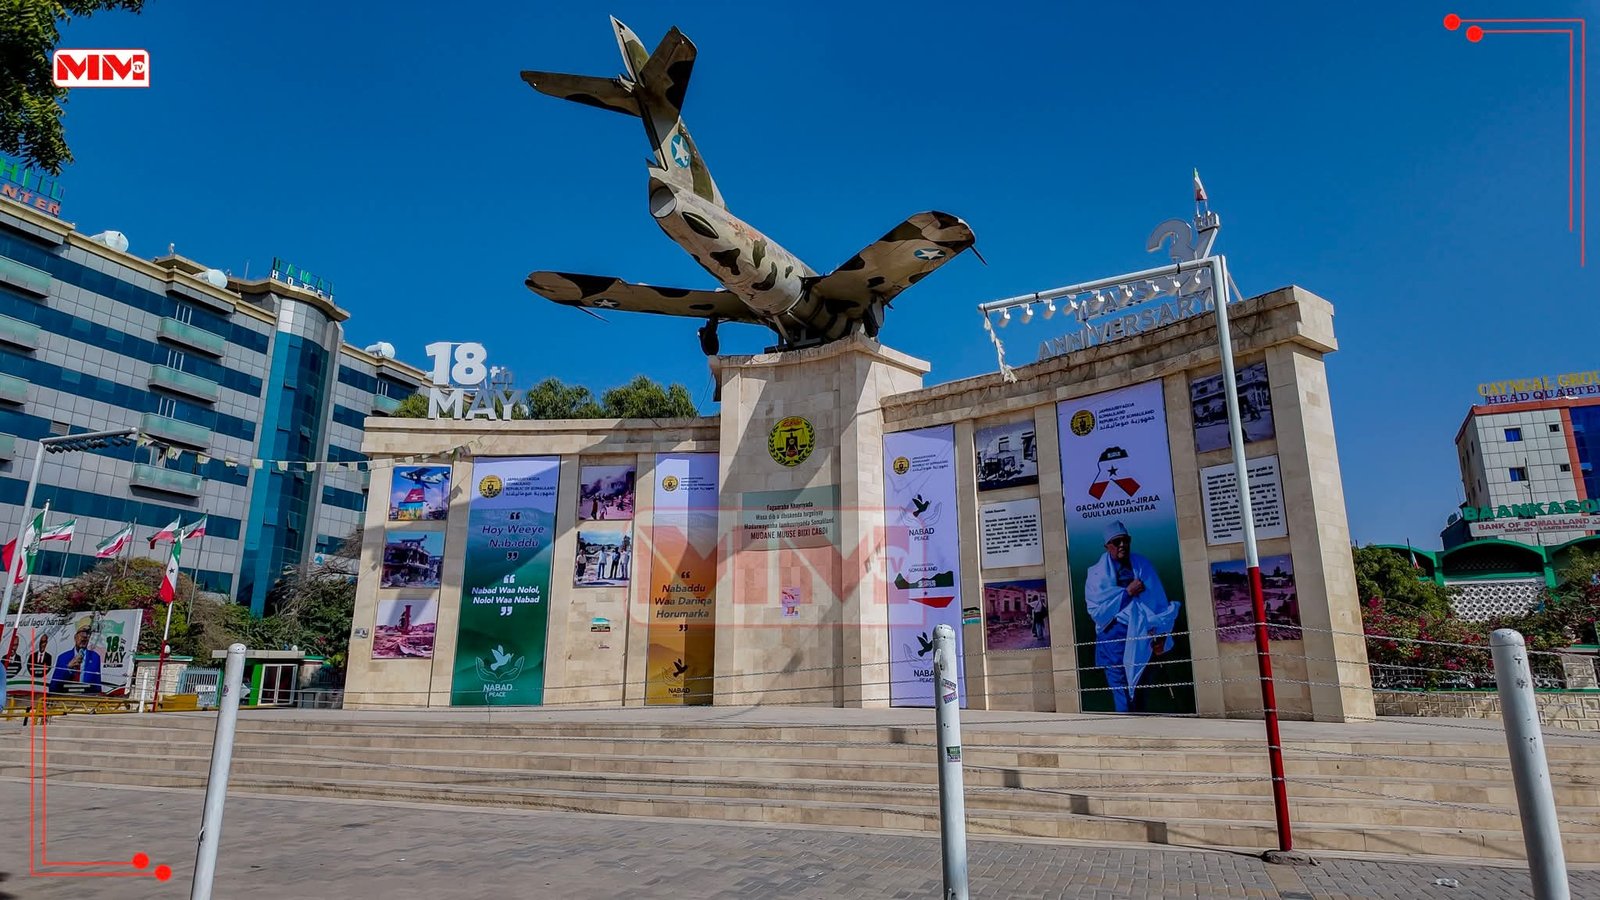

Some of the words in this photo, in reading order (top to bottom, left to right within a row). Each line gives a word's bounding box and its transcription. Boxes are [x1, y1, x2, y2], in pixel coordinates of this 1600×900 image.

[1038, 284, 1214, 361] ANNIVERSARY
[1487, 391, 1530, 405] HEAD
[1533, 384, 1600, 400] QUARTE
[427, 387, 521, 421] MAY
[1076, 502, 1105, 512] GACMO
[1106, 494, 1161, 508] WADA-JIRAA
[1082, 511, 1102, 519] GUUL
[1102, 508, 1122, 517] LAGU
[1123, 503, 1156, 514] HANTAA
[1478, 522, 1505, 531] BANK
[1508, 521, 1521, 529] OF
[1524, 518, 1591, 528] SOMALILAND
[482, 525, 504, 536] Hoy
[507, 524, 545, 536] Weeye
[751, 530, 775, 539] MUDANE
[776, 529, 796, 538] MUUSE
[908, 527, 935, 536] NABAD
[489, 539, 539, 548] Nabaddu
[472, 586, 497, 595] Nabad
[499, 586, 516, 594] Waa
[517, 585, 540, 595] Nolol,
[661, 583, 706, 593] Nabaddu
[473, 596, 494, 604] Nolol
[495, 596, 513, 604] Waa
[514, 595, 540, 603] Nabad
[654, 597, 675, 605] Waa
[656, 609, 709, 619] Horumarka
[106, 635, 120, 652] 18
[103, 652, 127, 664] MAY
[913, 669, 935, 677] NABA
[482, 683, 513, 692] NABAD
